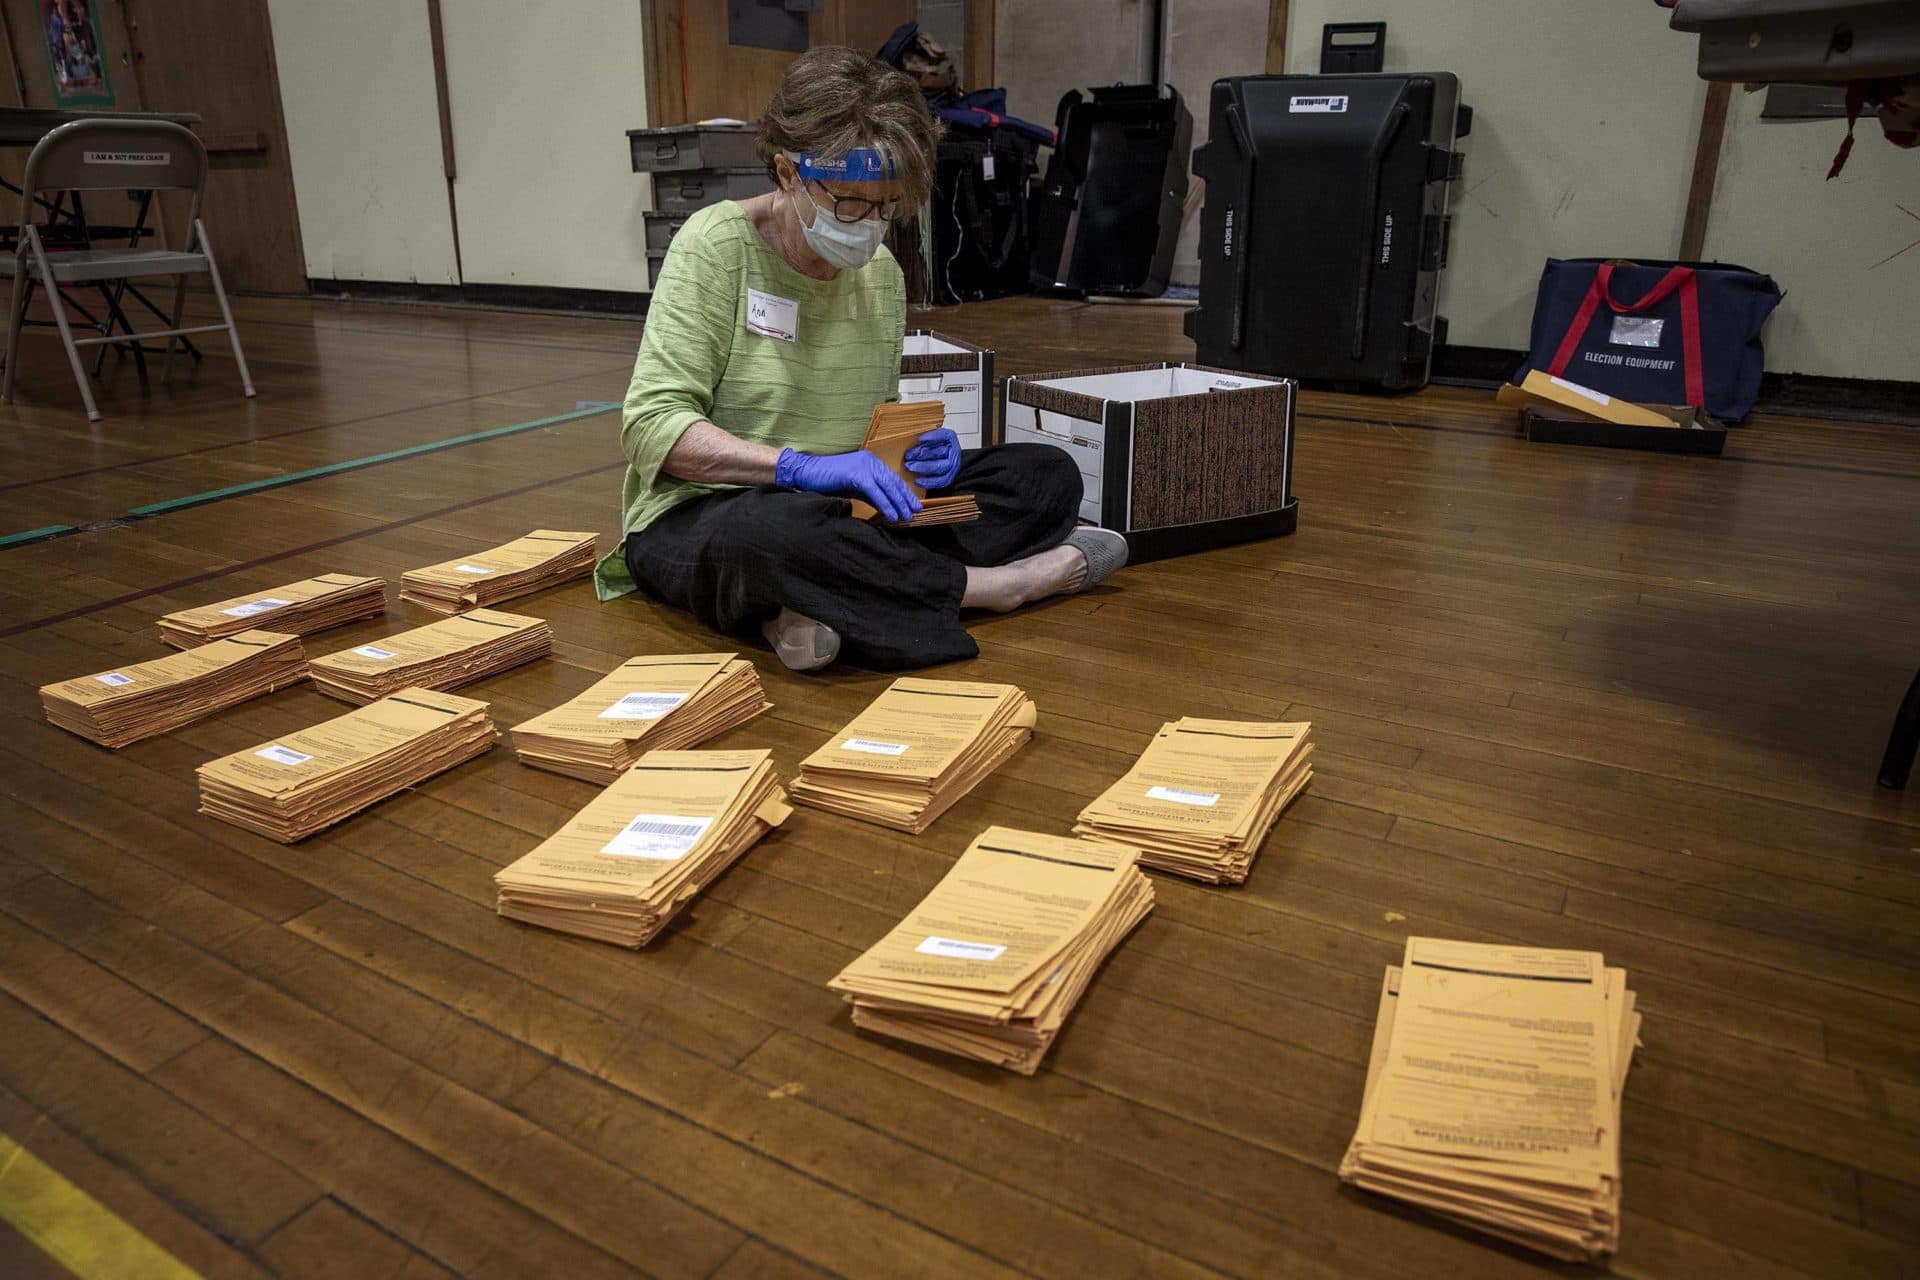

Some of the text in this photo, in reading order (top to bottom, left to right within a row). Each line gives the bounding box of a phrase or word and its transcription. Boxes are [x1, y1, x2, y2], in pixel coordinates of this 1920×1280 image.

[1225, 209, 1233, 226] THIS
[1381, 215, 1392, 264] THIS SIDE UP
[1224, 245, 1231, 256] UP
[1584, 352, 1675, 370] ELECTION EQUIPMENT
